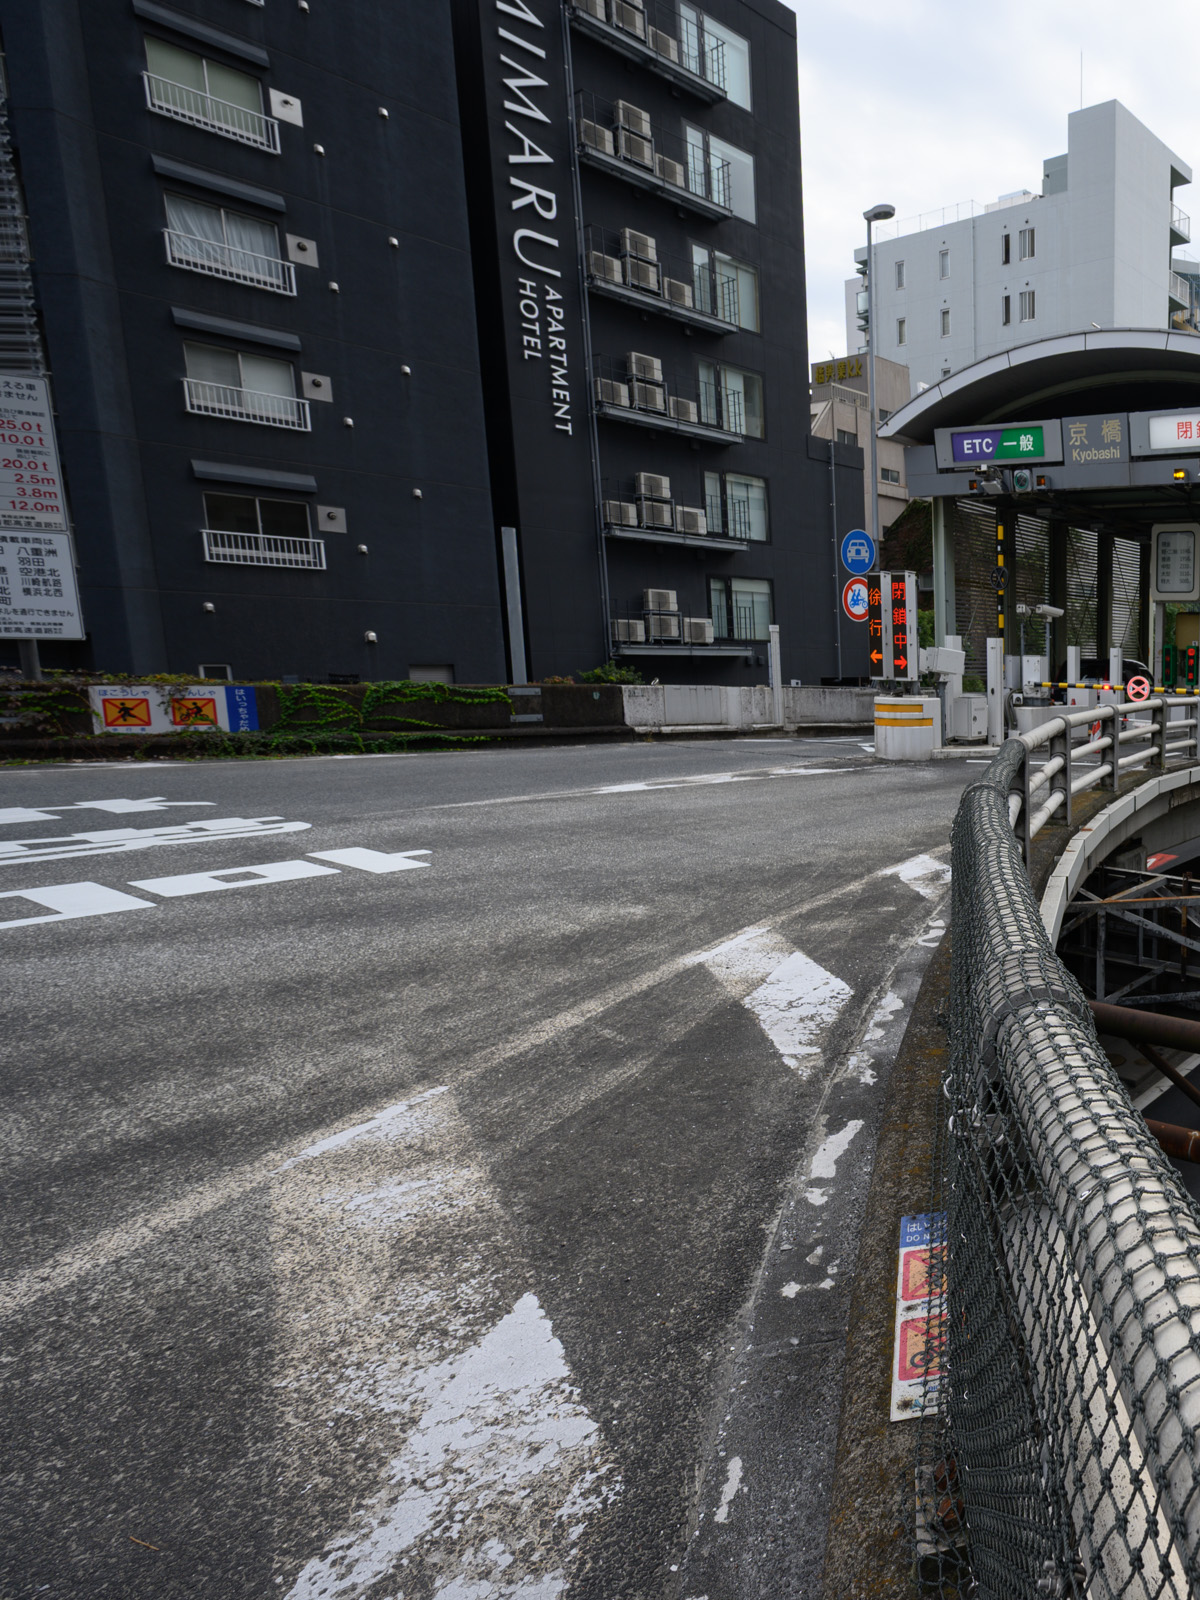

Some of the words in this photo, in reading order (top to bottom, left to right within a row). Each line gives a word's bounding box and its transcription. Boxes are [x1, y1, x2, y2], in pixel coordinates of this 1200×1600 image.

[518, 277, 542, 361] HOTEL
[545, 284, 573, 435] APARTMENT
[1069, 419, 1122, 446] 京橋
[963, 438, 993, 454] ETC
[1003, 434, 1034, 452] 一般
[1072, 447, 1120, 463] Kyobashi
[14, 473, 56, 485] 2.5m
[16, 487, 58, 499] 3.8m
[9, 500, 60, 513] 12.0m
[18, 557, 45, 566] 羽田
[19, 567, 60, 577] 空港北
[868, 588, 882, 637] 徐行
[892, 582, 907, 649] 閉鎖中
[906, 1234, 920, 1243] DO
